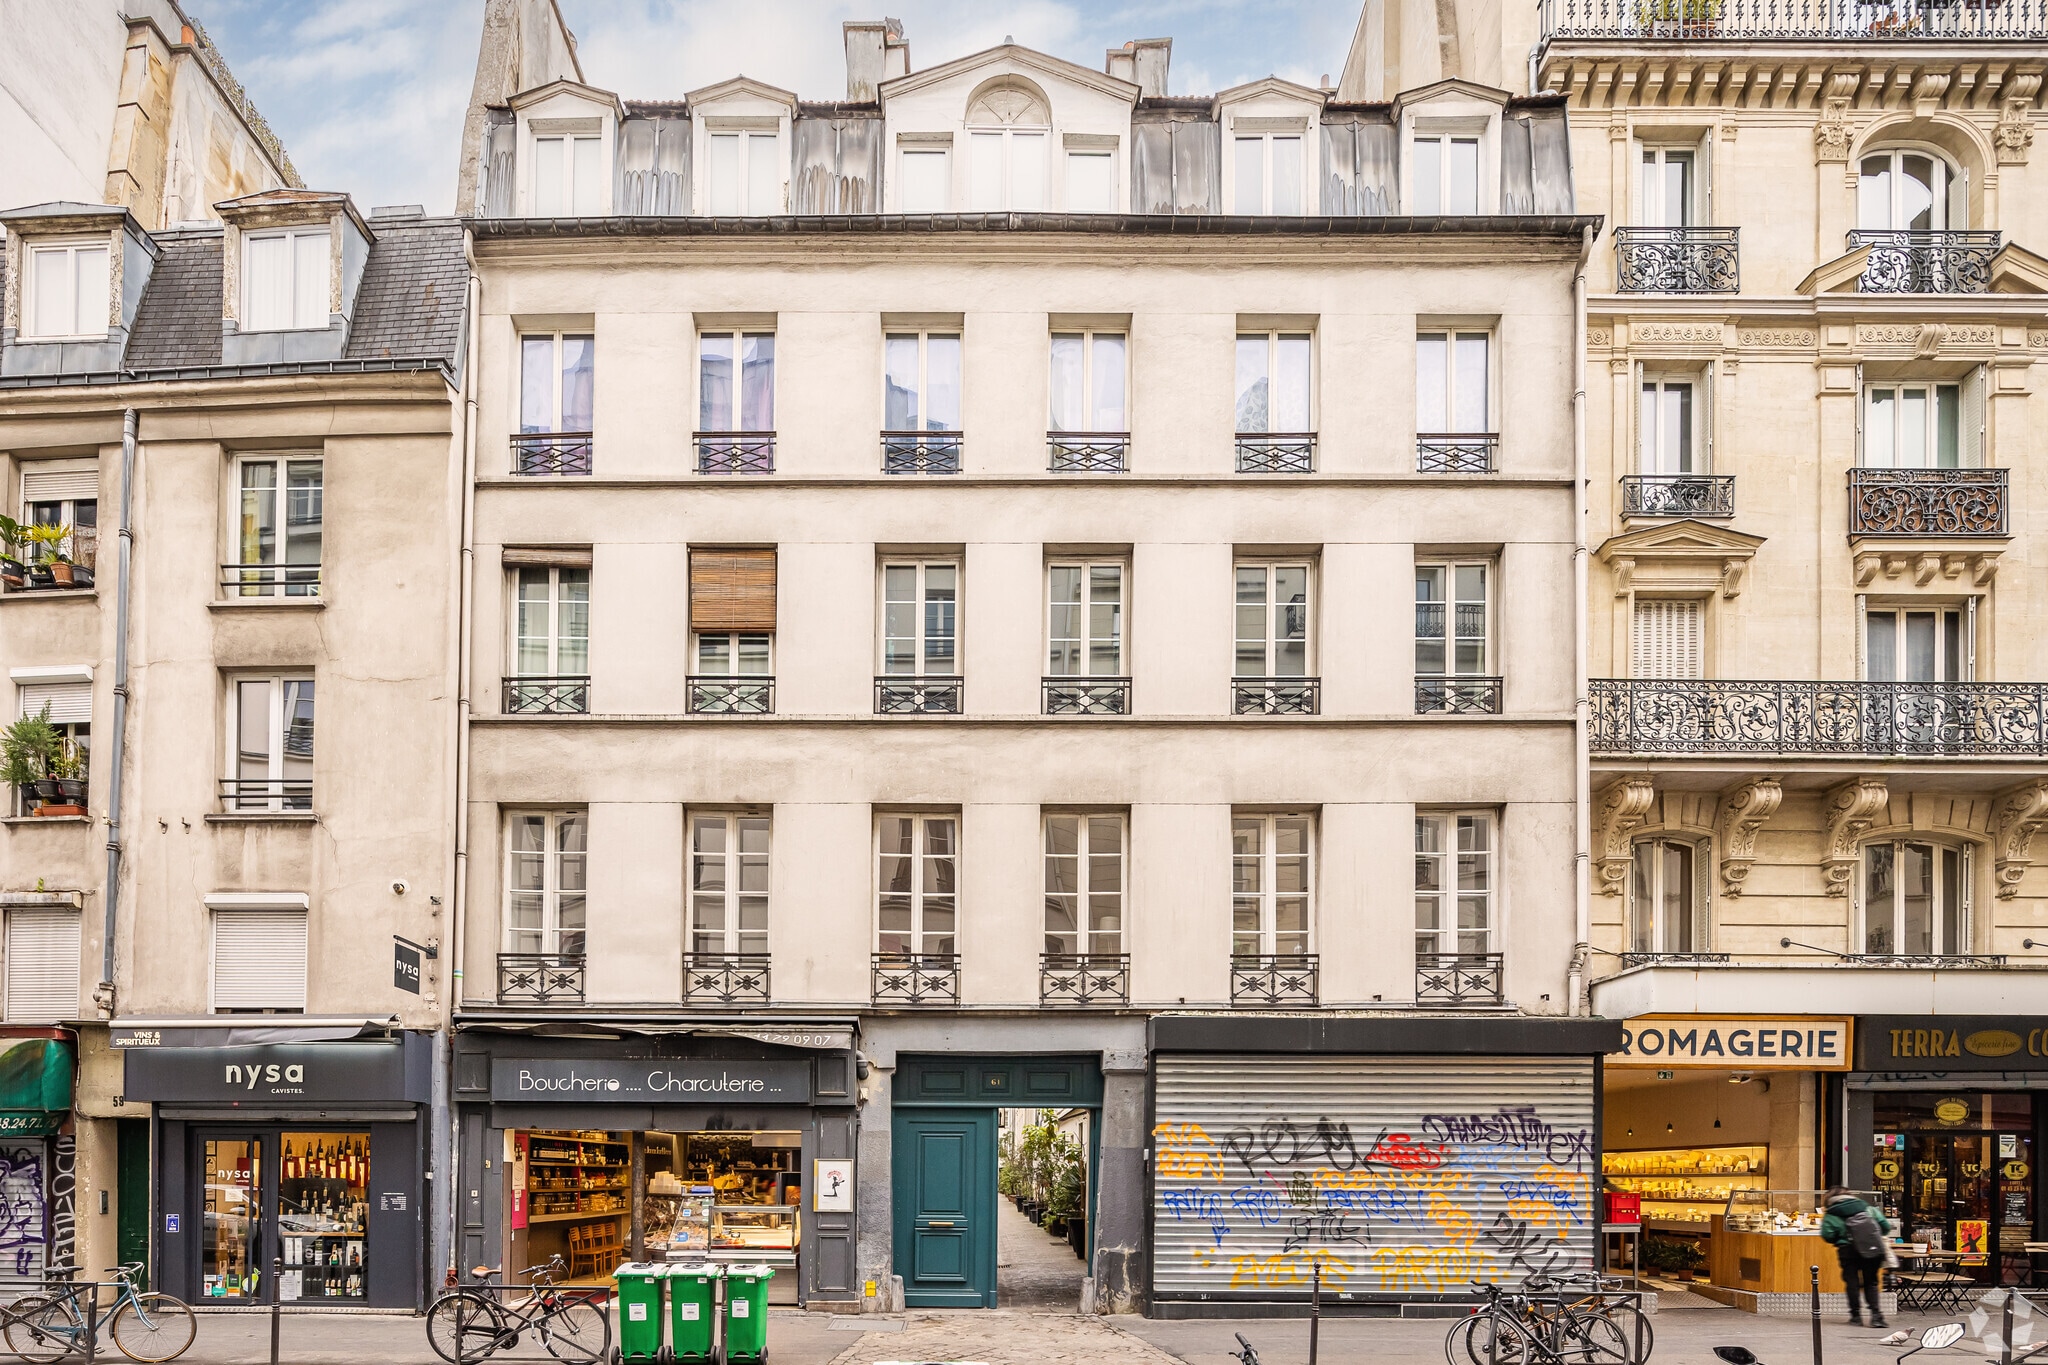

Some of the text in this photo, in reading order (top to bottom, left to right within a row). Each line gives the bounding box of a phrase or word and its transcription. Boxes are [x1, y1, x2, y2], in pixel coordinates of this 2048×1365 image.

[396, 959, 419, 976] nysa
[115, 1038, 160, 1046] SPIRITUEUX
[793, 1035, 811, 1044] 09
[814, 1035, 832, 1046] 07
[1889, 1028, 1961, 1057] TERRA
[225, 1064, 304, 1090] nysa
[519, 1070, 620, 1091] Boucherie
[647, 1070, 764, 1092] Charcuterie
[1880, 1163, 1895, 1173] TC
[1967, 1163, 1979, 1172] TC
[2009, 1163, 2024, 1174] TC
[217, 1169, 250, 1181] nysa
